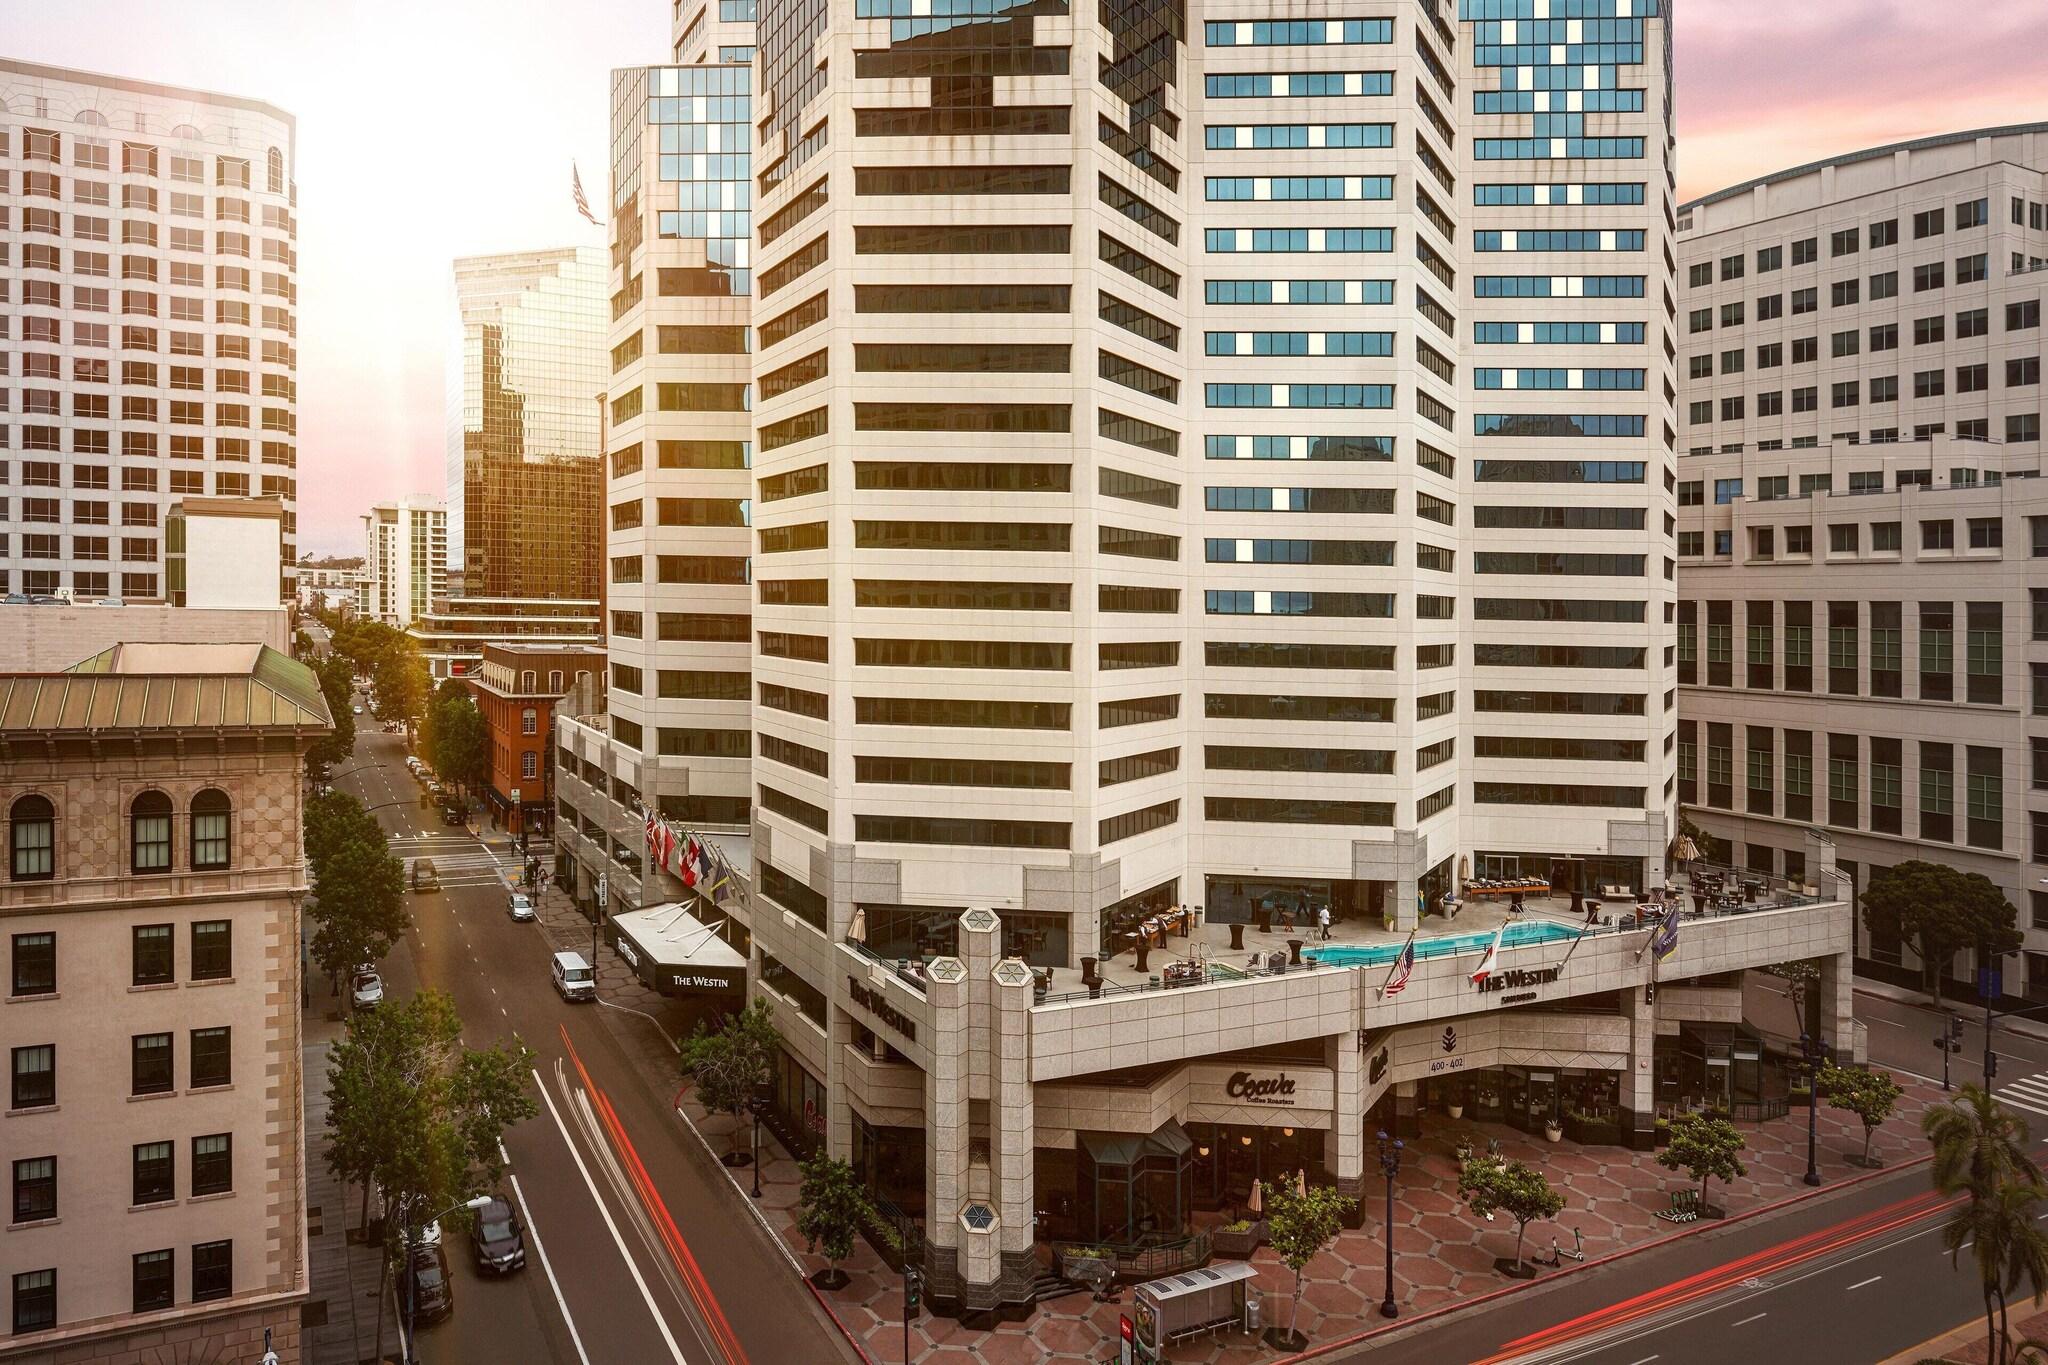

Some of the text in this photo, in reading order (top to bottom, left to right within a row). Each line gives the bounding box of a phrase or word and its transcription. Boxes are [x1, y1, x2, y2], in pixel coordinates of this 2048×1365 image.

[673, 975, 729, 988] THE WESTIN
[1504, 968, 1558, 988] WESTIN
[1431, 1062, 1445, 1073] 400
[1449, 1058, 1463, 1069] 402
[1226, 1071, 1296, 1098] Coava
